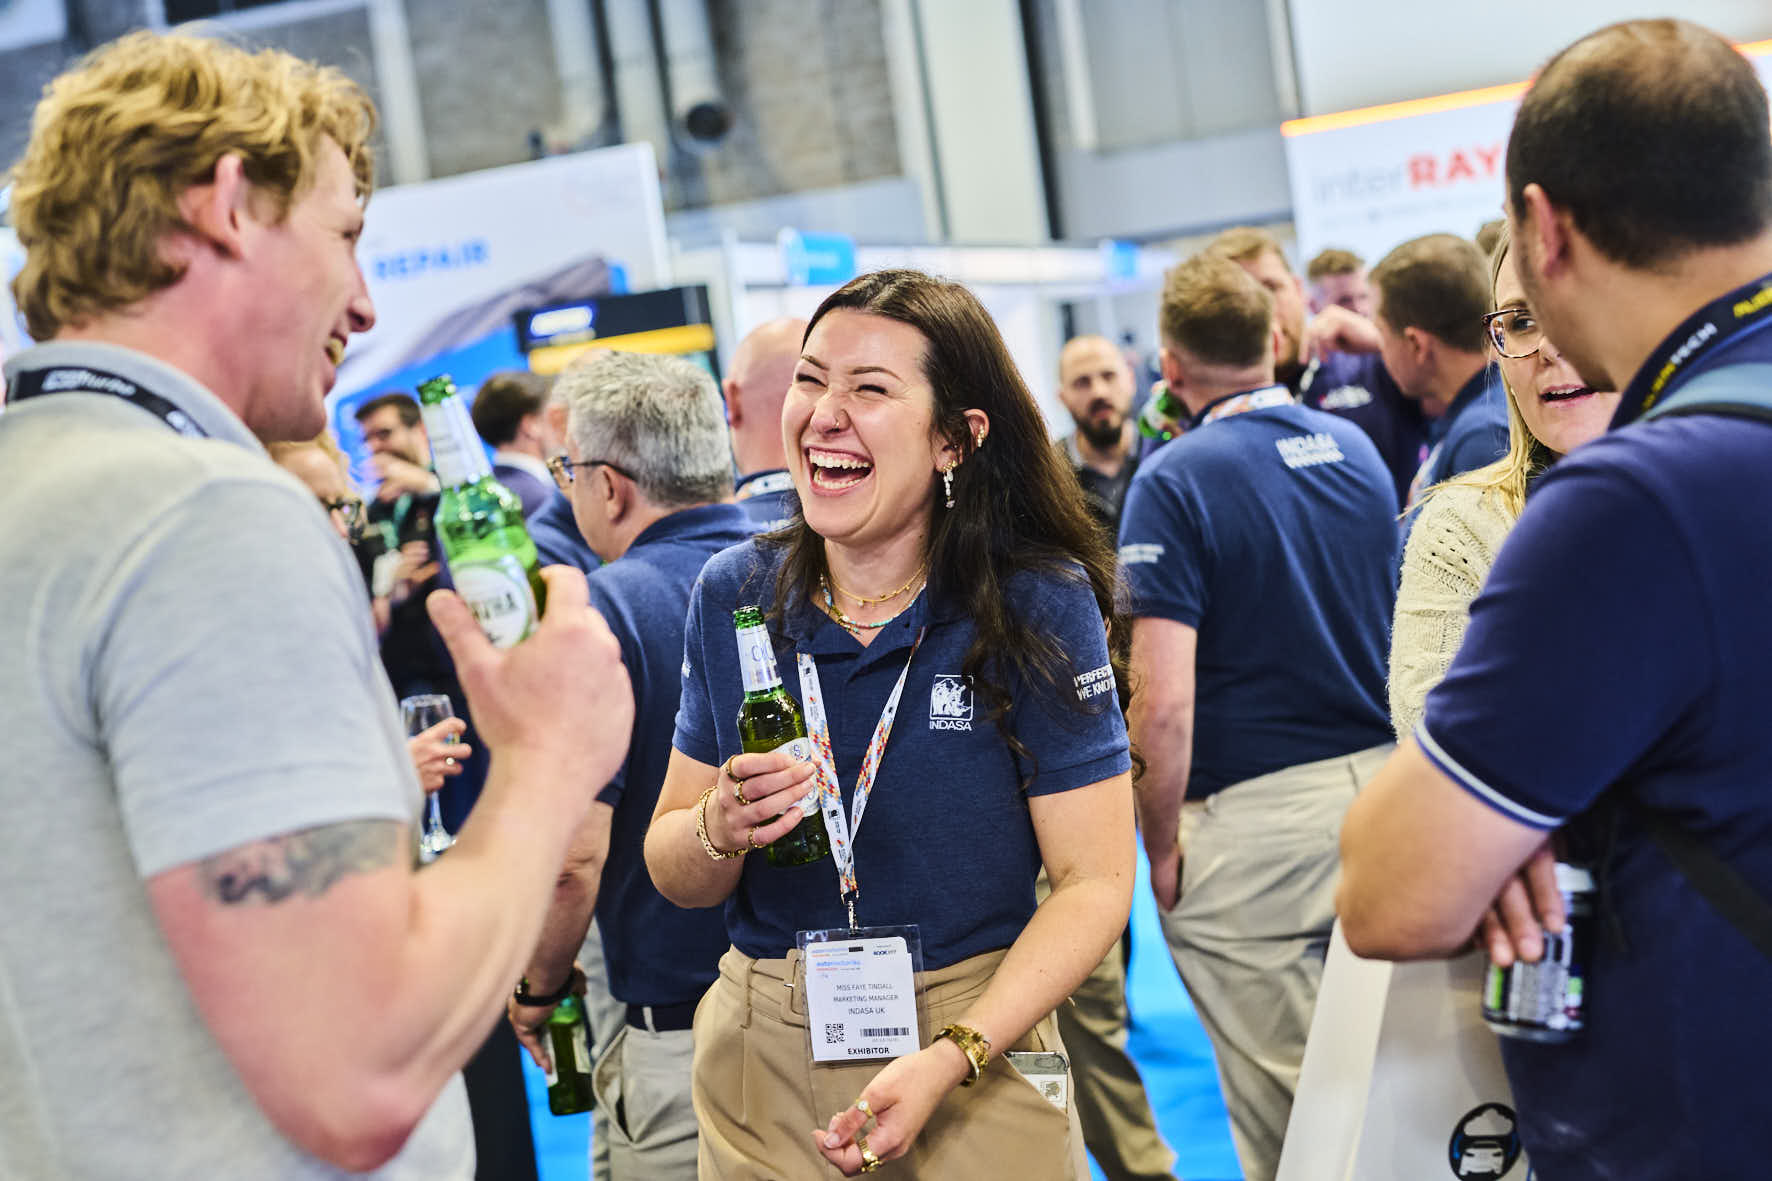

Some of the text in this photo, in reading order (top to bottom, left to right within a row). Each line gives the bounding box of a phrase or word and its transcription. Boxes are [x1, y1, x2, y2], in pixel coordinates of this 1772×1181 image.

[1076, 685, 1093, 701] WE
[929, 720, 972, 731] INDASA
[848, 1007, 874, 1015] INDASA
[847, 1047, 890, 1055] EXHIBITOR
